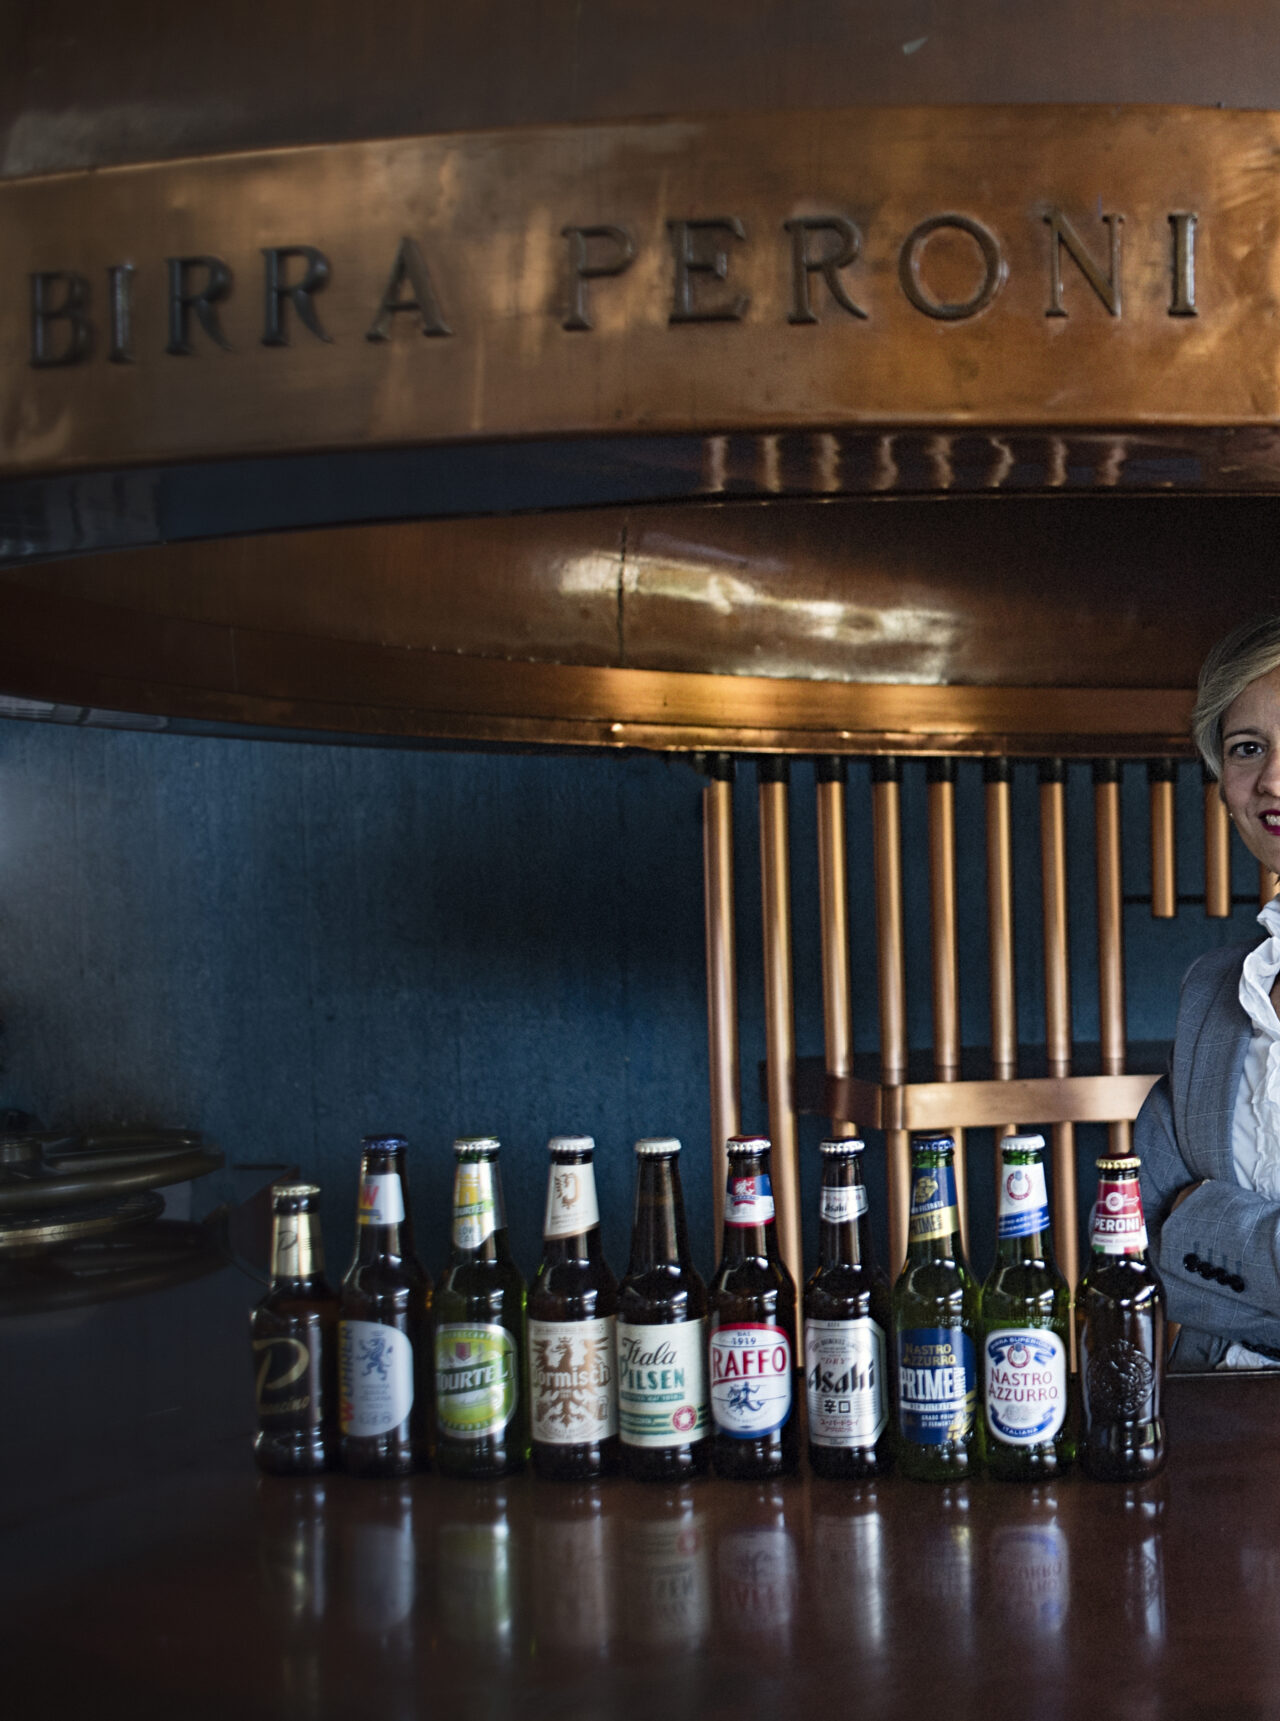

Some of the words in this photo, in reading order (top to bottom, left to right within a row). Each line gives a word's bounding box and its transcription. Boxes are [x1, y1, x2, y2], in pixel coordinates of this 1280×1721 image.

[28, 237, 453, 369] BIRRA
[560, 208, 1199, 332] PERONI
[1095, 1217, 1139, 1231] PERONI
[622, 1336, 677, 1367] Itala
[732, 1337, 757, 1346] 1919
[905, 1343, 952, 1356] NASTRO
[711, 1346, 788, 1379] RAFFO
[903, 1355, 957, 1367] AZZURRO
[618, 1357, 686, 1391] PILSEN
[807, 1359, 875, 1394] Asahi
[900, 1366, 954, 1401] PRIME
[991, 1367, 1053, 1386] NASTRO
[989, 1383, 1058, 1402] AZZURRO
